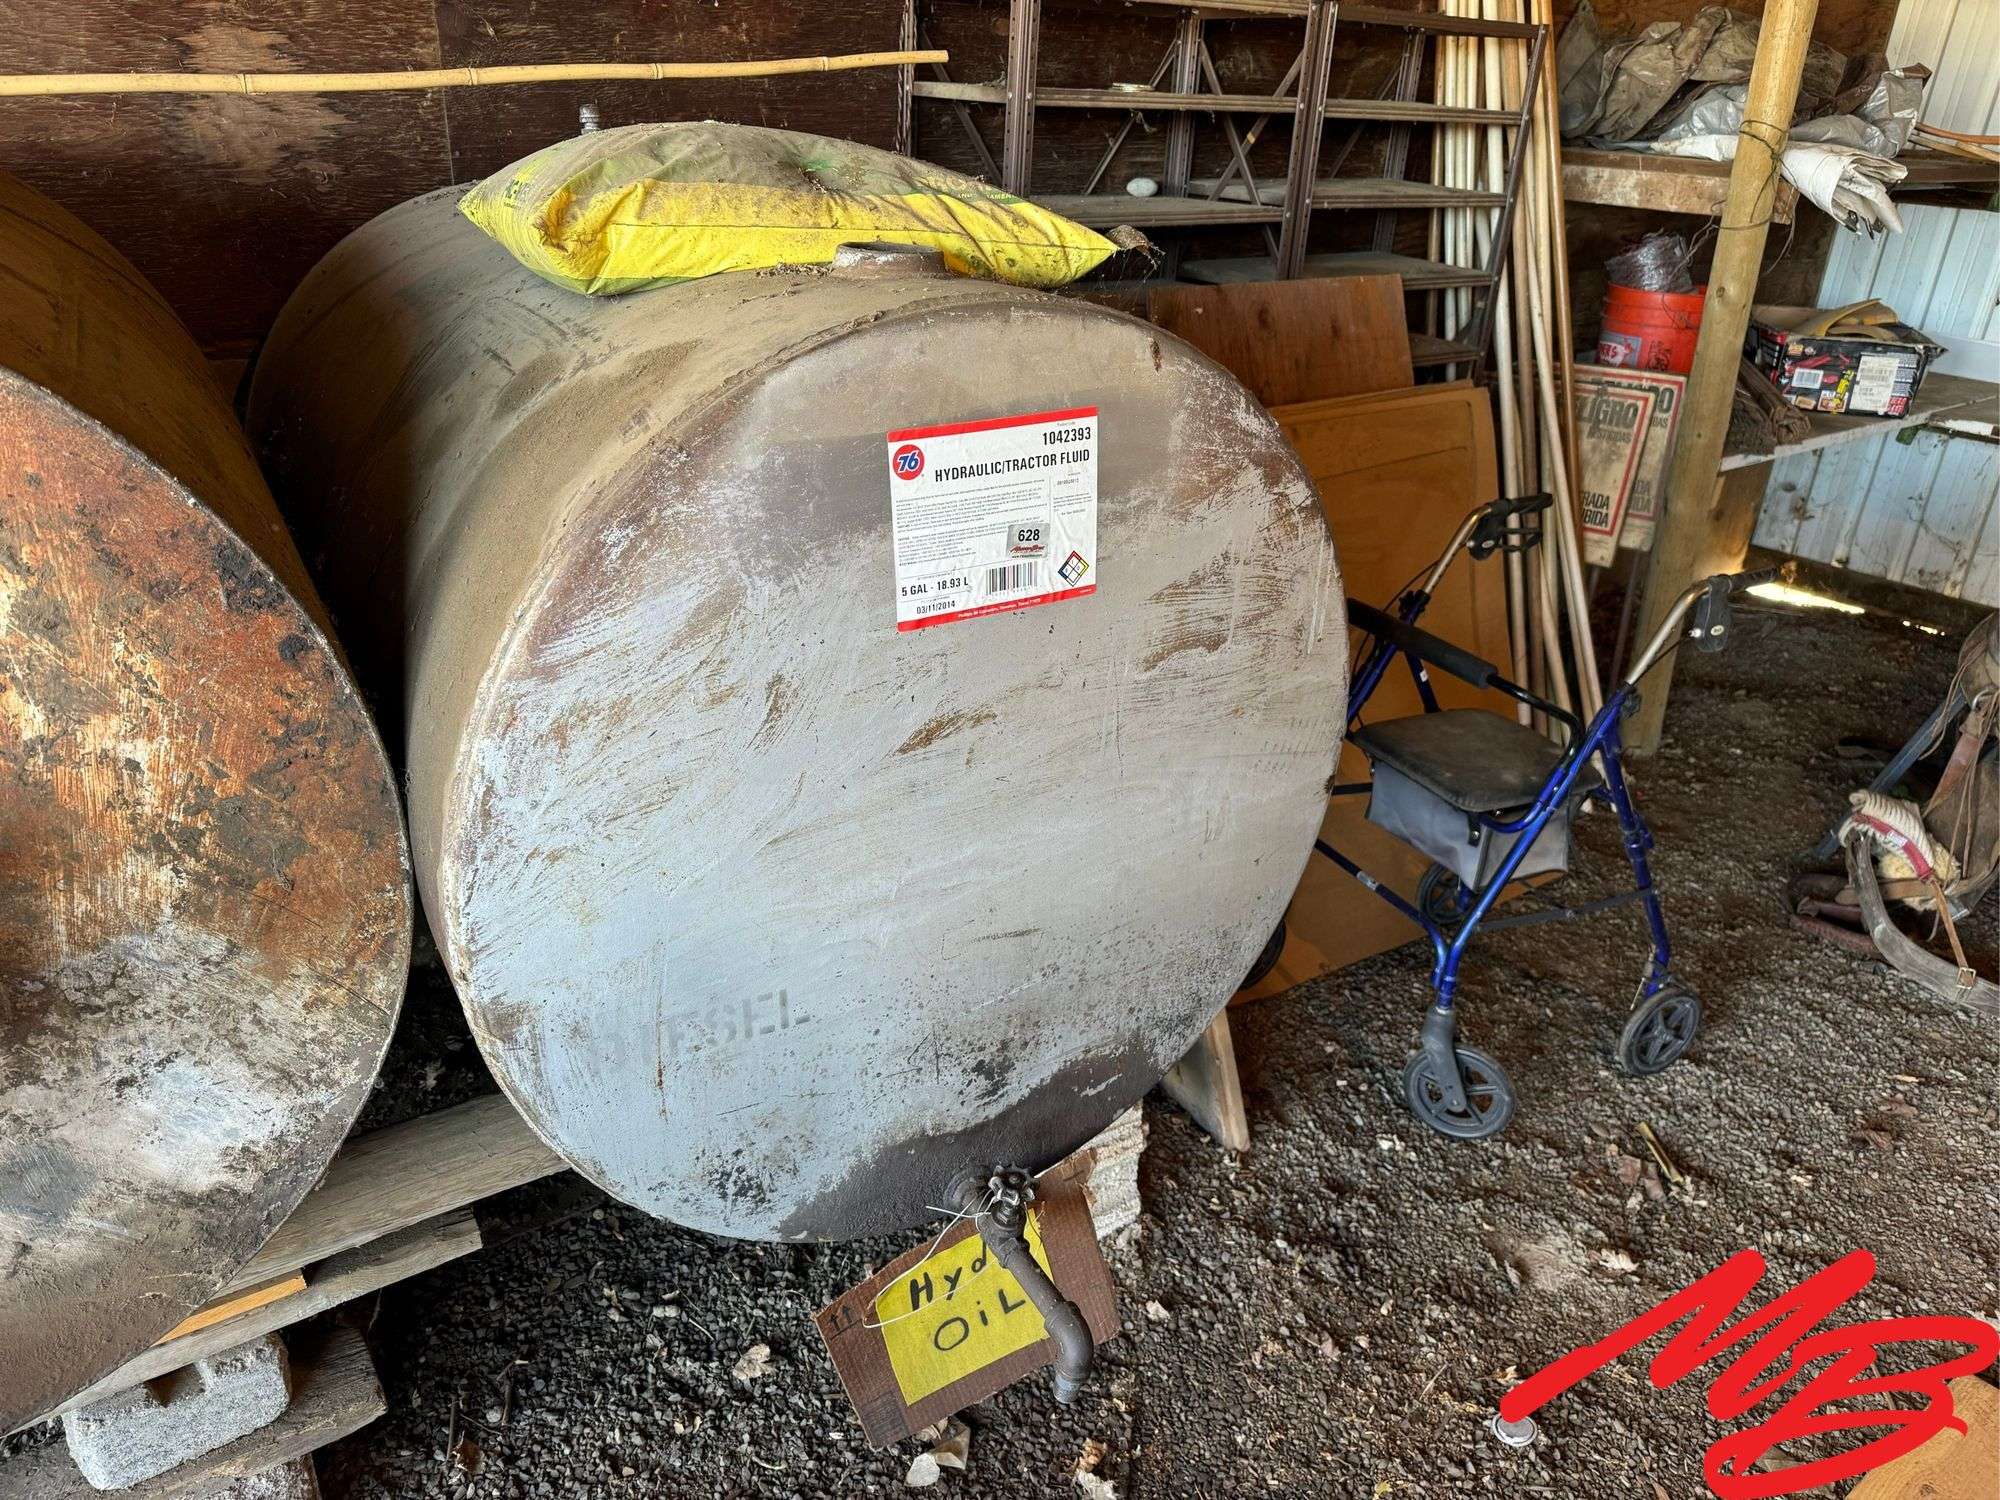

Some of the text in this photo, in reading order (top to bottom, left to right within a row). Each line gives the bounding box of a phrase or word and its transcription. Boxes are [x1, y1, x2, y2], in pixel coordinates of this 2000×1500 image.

[1042, 426, 1091, 446] 1042393
[898, 452, 919, 471] 76
[935, 454, 1057, 482] HYDRAULIC/TRACTOR
[1060, 449, 1090, 466] FLUID
[1583, 491, 1610, 510] RADA
[1017, 529, 1040, 542] 628
[901, 586, 908, 597] 5
[910, 582, 928, 594] GAL
[937, 578, 961, 592] 18.93
[963, 577, 969, 586] L
[916, 600, 956, 614] 03/11/2014
[909, 1242, 987, 1311] Hyd
